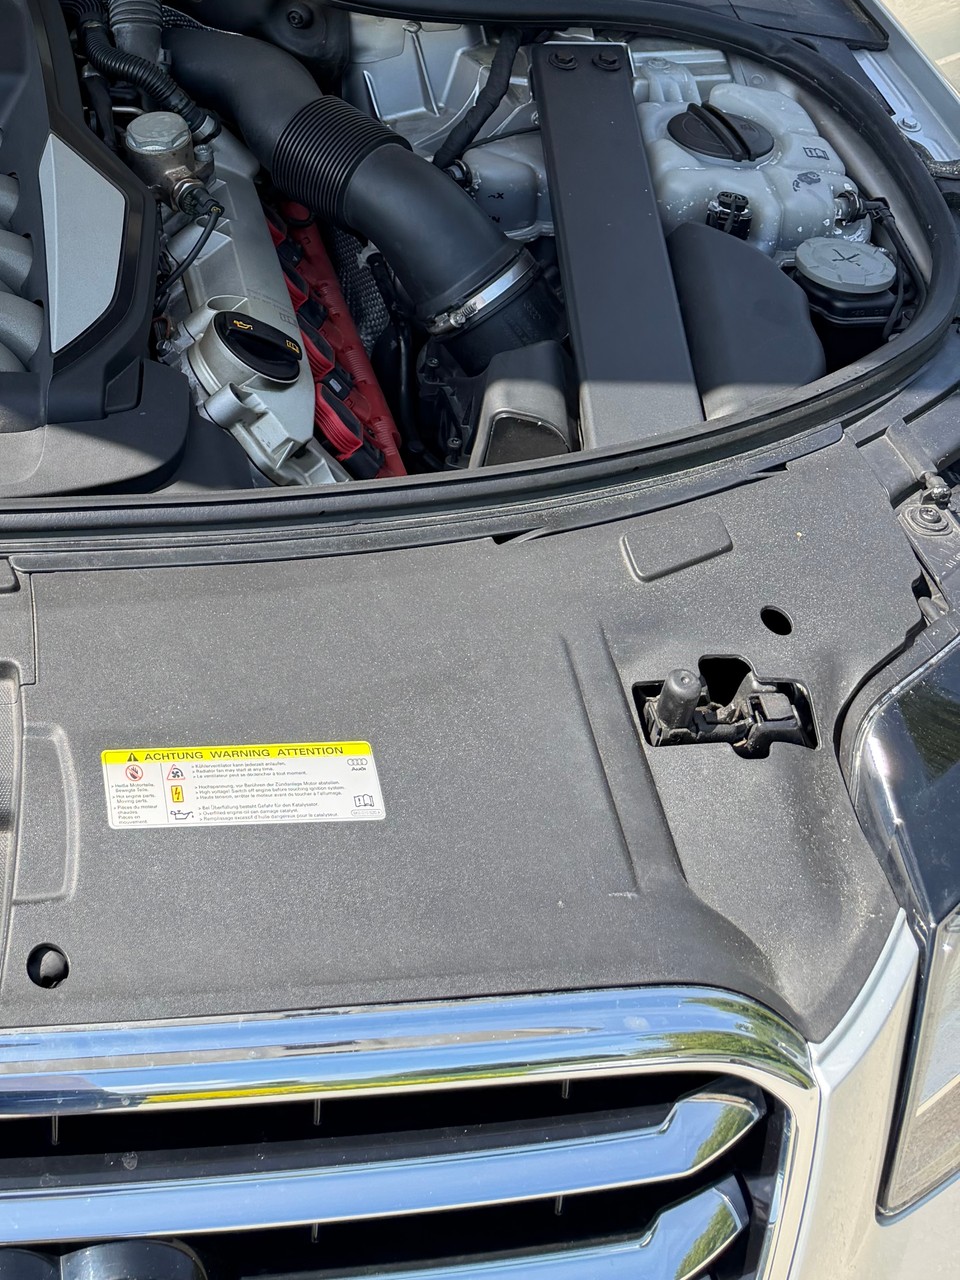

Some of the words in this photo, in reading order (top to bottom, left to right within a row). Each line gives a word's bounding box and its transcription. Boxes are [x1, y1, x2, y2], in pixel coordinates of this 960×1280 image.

[144, 751, 204, 761] ACHTUNG
[209, 749, 270, 758] WARNING
[277, 746, 344, 756] ATTENTION
